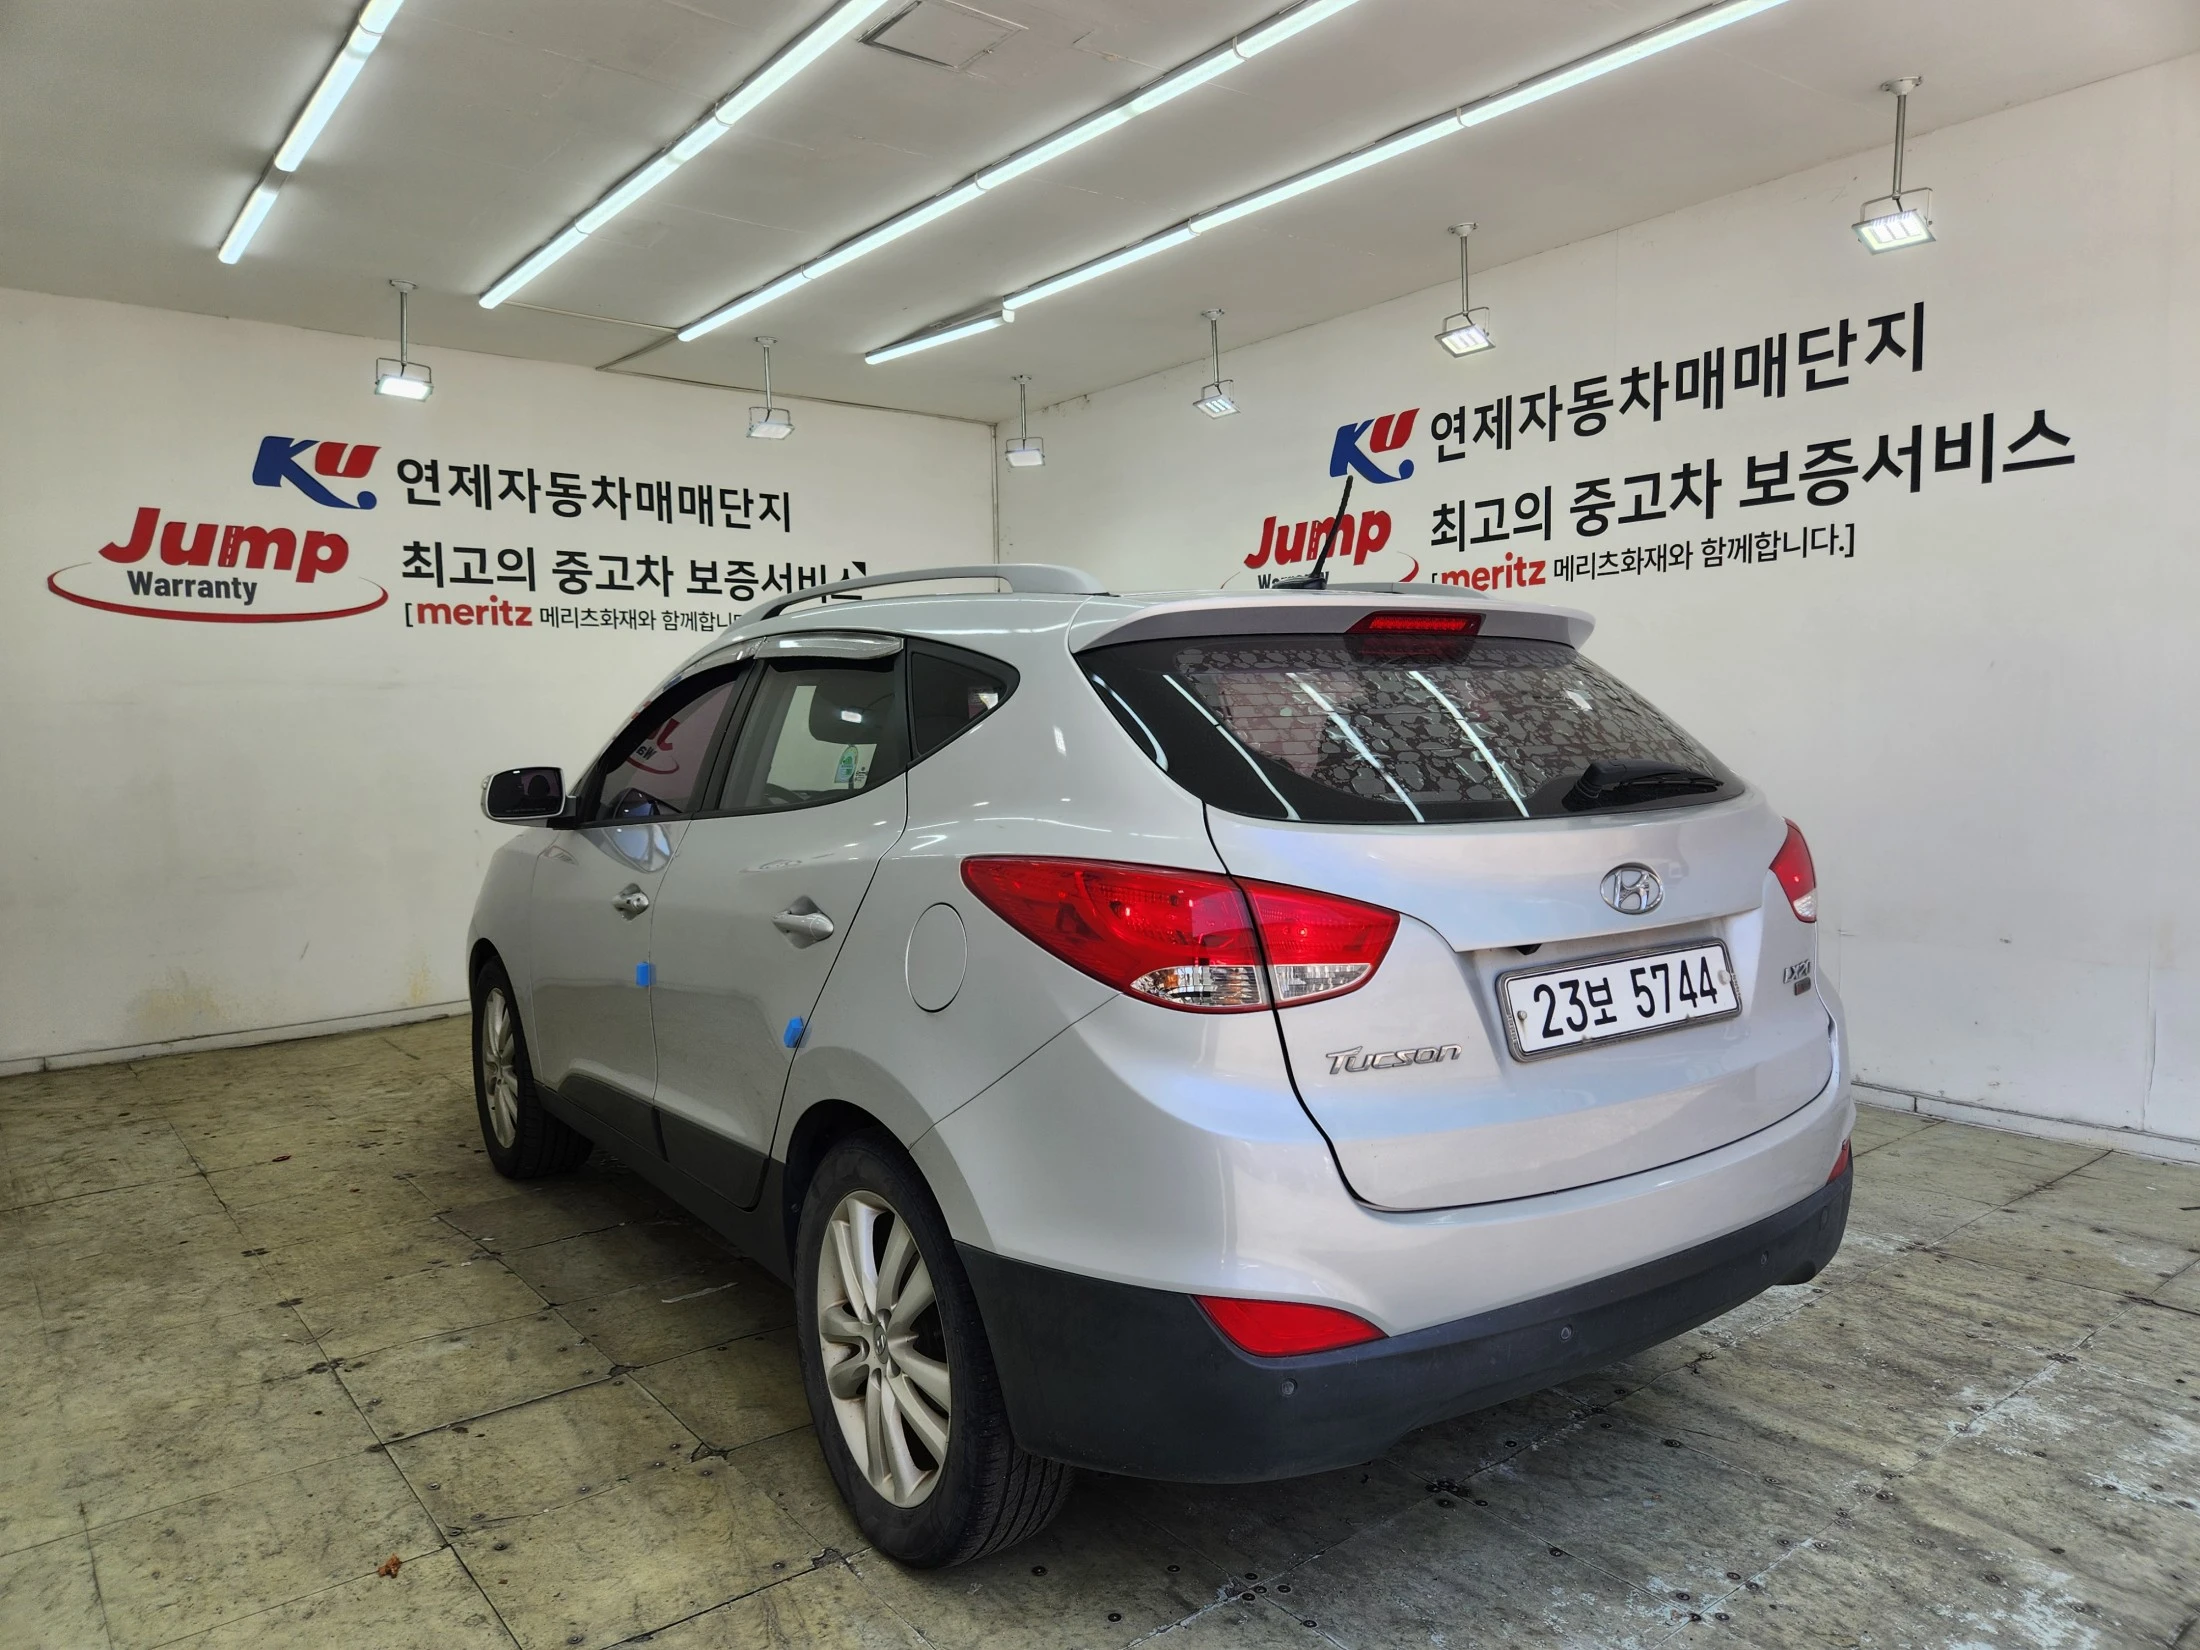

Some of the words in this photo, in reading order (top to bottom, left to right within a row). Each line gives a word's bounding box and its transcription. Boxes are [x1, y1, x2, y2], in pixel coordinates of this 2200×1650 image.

[1430, 301, 1925, 461] 연제자동차매매단지
[396, 459, 791, 533] 연제자동차매매단지
[1430, 485, 1552, 553] 최고의
[1570, 459, 1723, 541] 중고차
[1739, 409, 2076, 510] 보증서비스
[98, 507, 350, 584] Jump
[402, 540, 536, 592] 최고의
[552, 546, 675, 598] 중고차
[1243, 510, 1392, 569] Jump
[1553, 540, 1694, 583] 메리츠화재와
[126, 570, 258, 606] Warranty
[539, 607, 657, 631] 메리츠화재와
[1533, 977, 1617, 1039] 23보
[1630, 956, 1718, 1018] 5744
